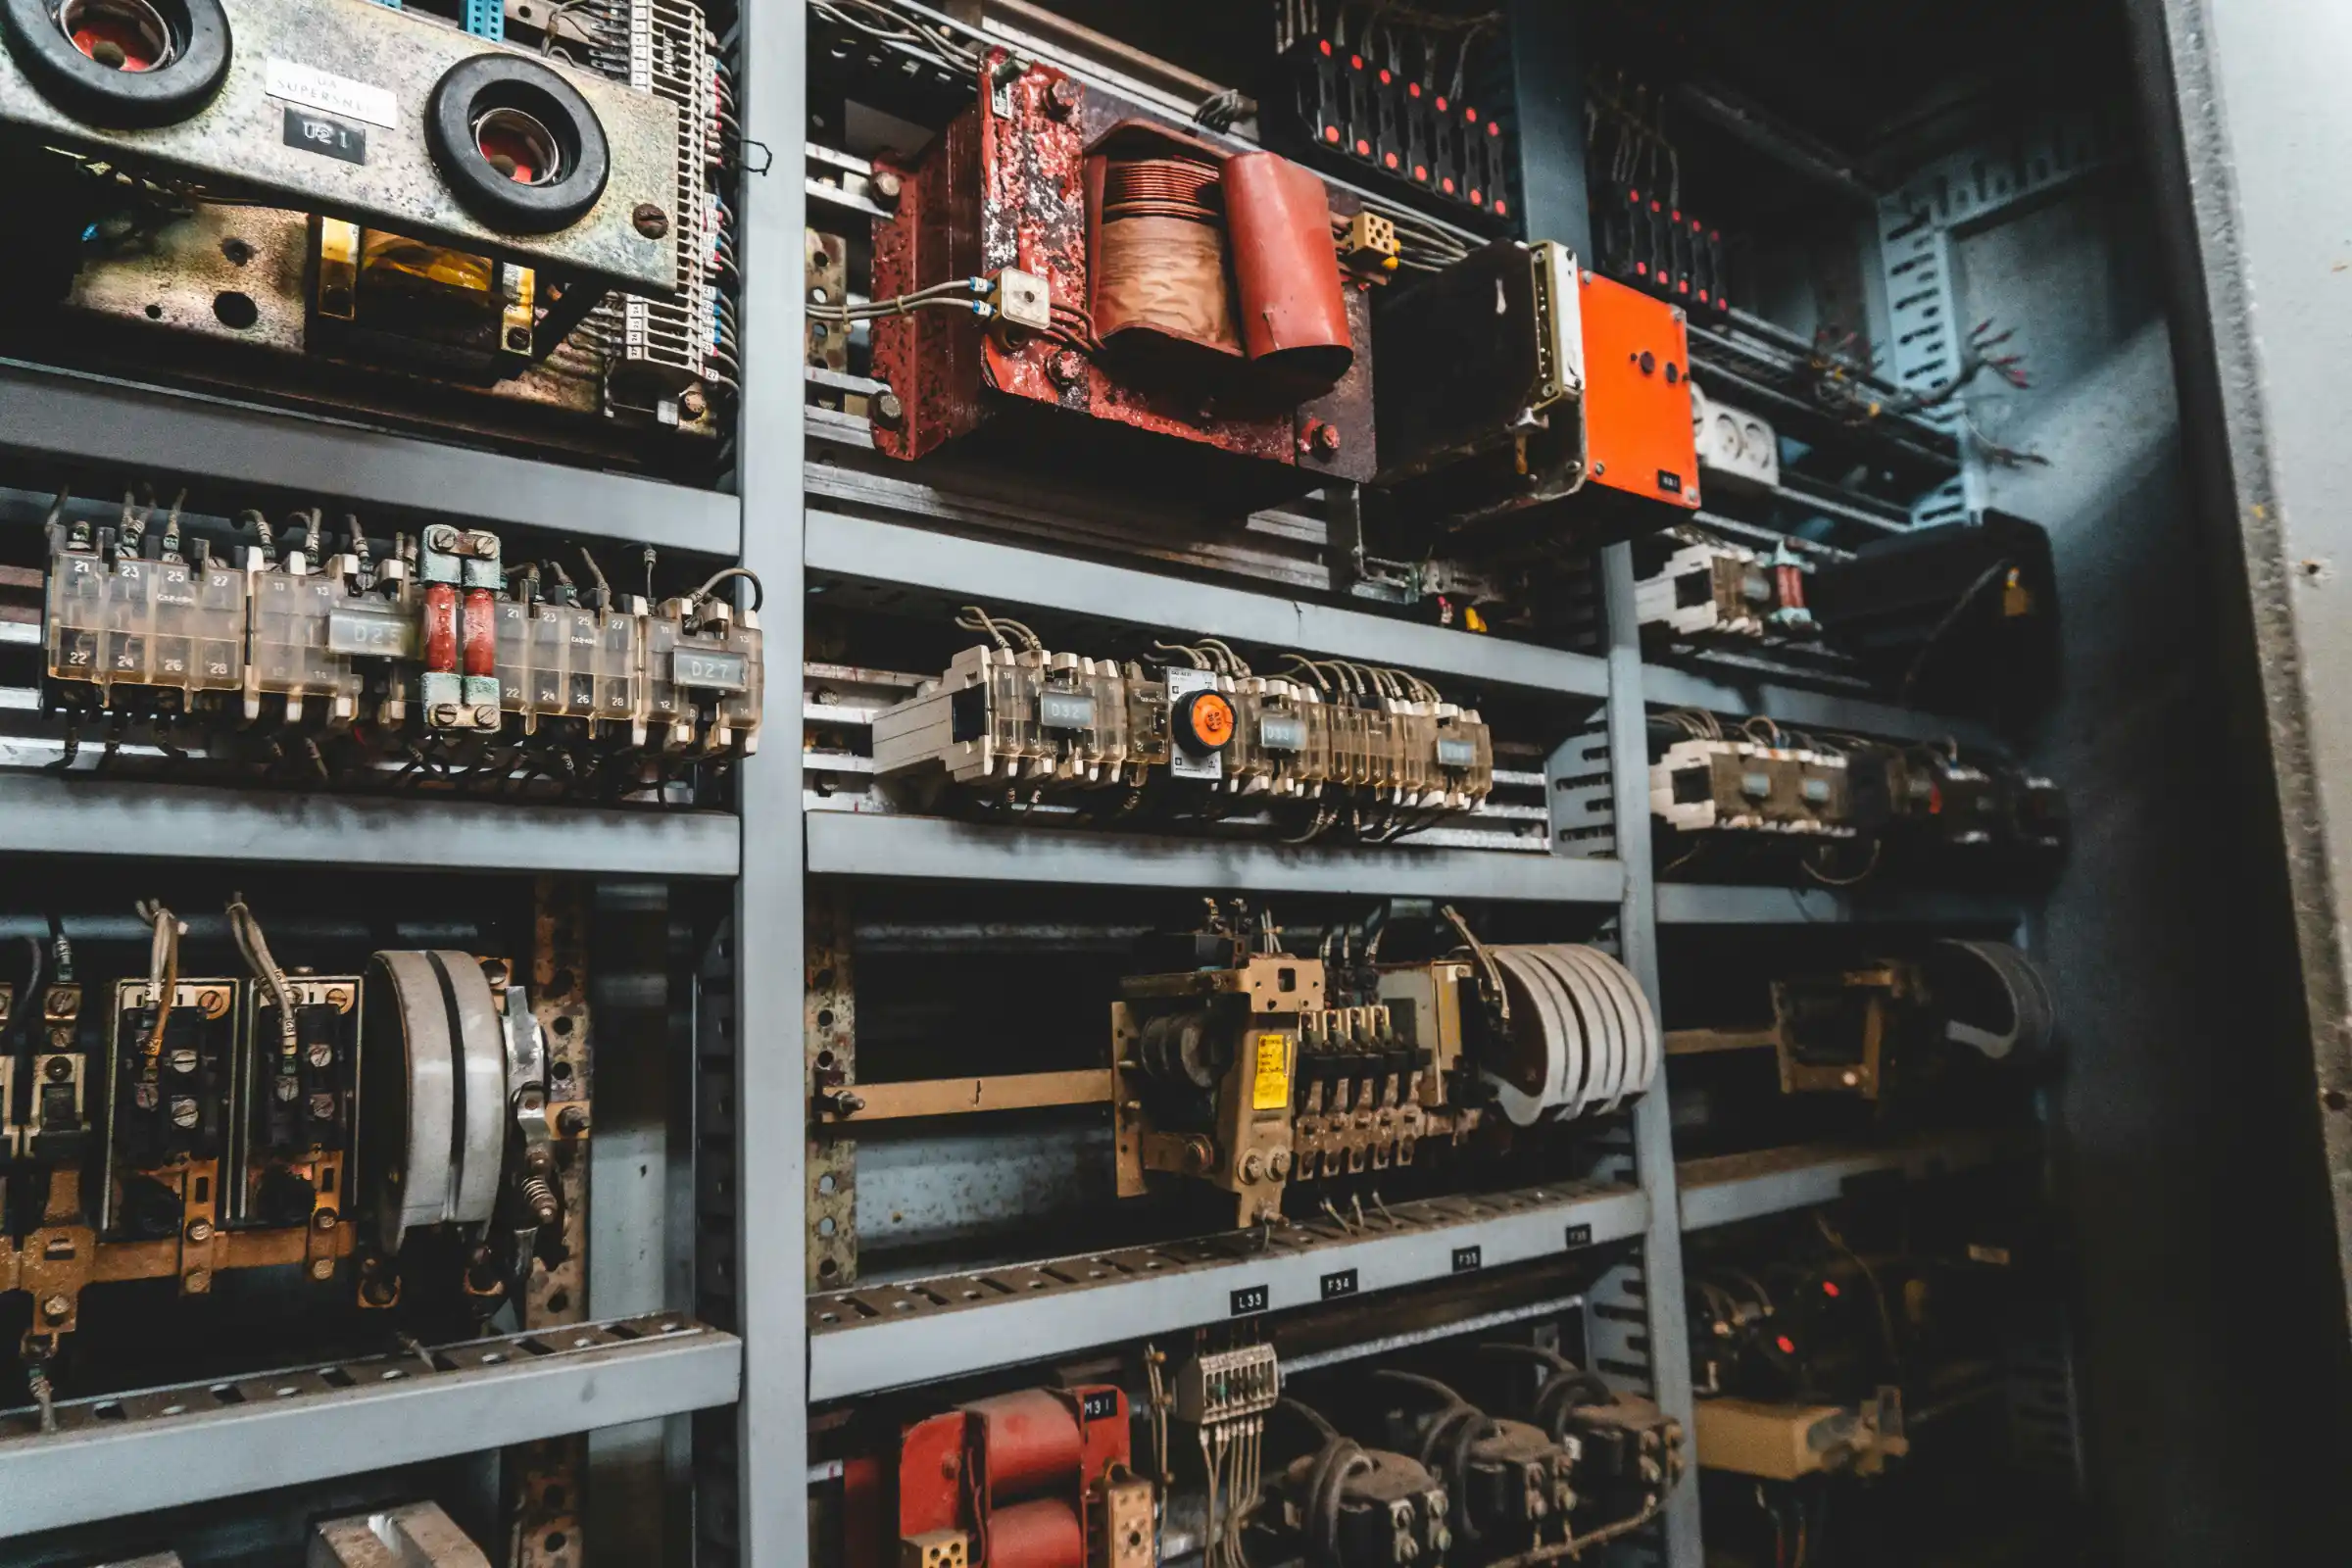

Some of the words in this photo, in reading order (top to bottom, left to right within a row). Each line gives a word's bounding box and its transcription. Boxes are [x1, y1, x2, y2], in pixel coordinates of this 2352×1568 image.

[277, 77, 369, 114] SUPERSN
[74, 560, 90, 573] 21
[121, 565, 140, 578] 23
[166, 570, 185, 583] 25
[543, 612, 557, 623] 23
[612, 618, 624, 630] 27
[69, 651, 87, 665] 22
[118, 655, 134, 668] 24
[165, 659, 184, 672] 26
[210, 662, 228, 675] 28
[691, 661, 729, 679] D27
[506, 687, 520, 699] 22
[542, 690, 556, 702] 24
[576, 694, 590, 705] 26
[612, 697, 624, 707] 28
[1051, 704, 1080, 718] D32
[1239, 1293, 1262, 1309] L33
[1083, 1397, 1109, 1416] M31
